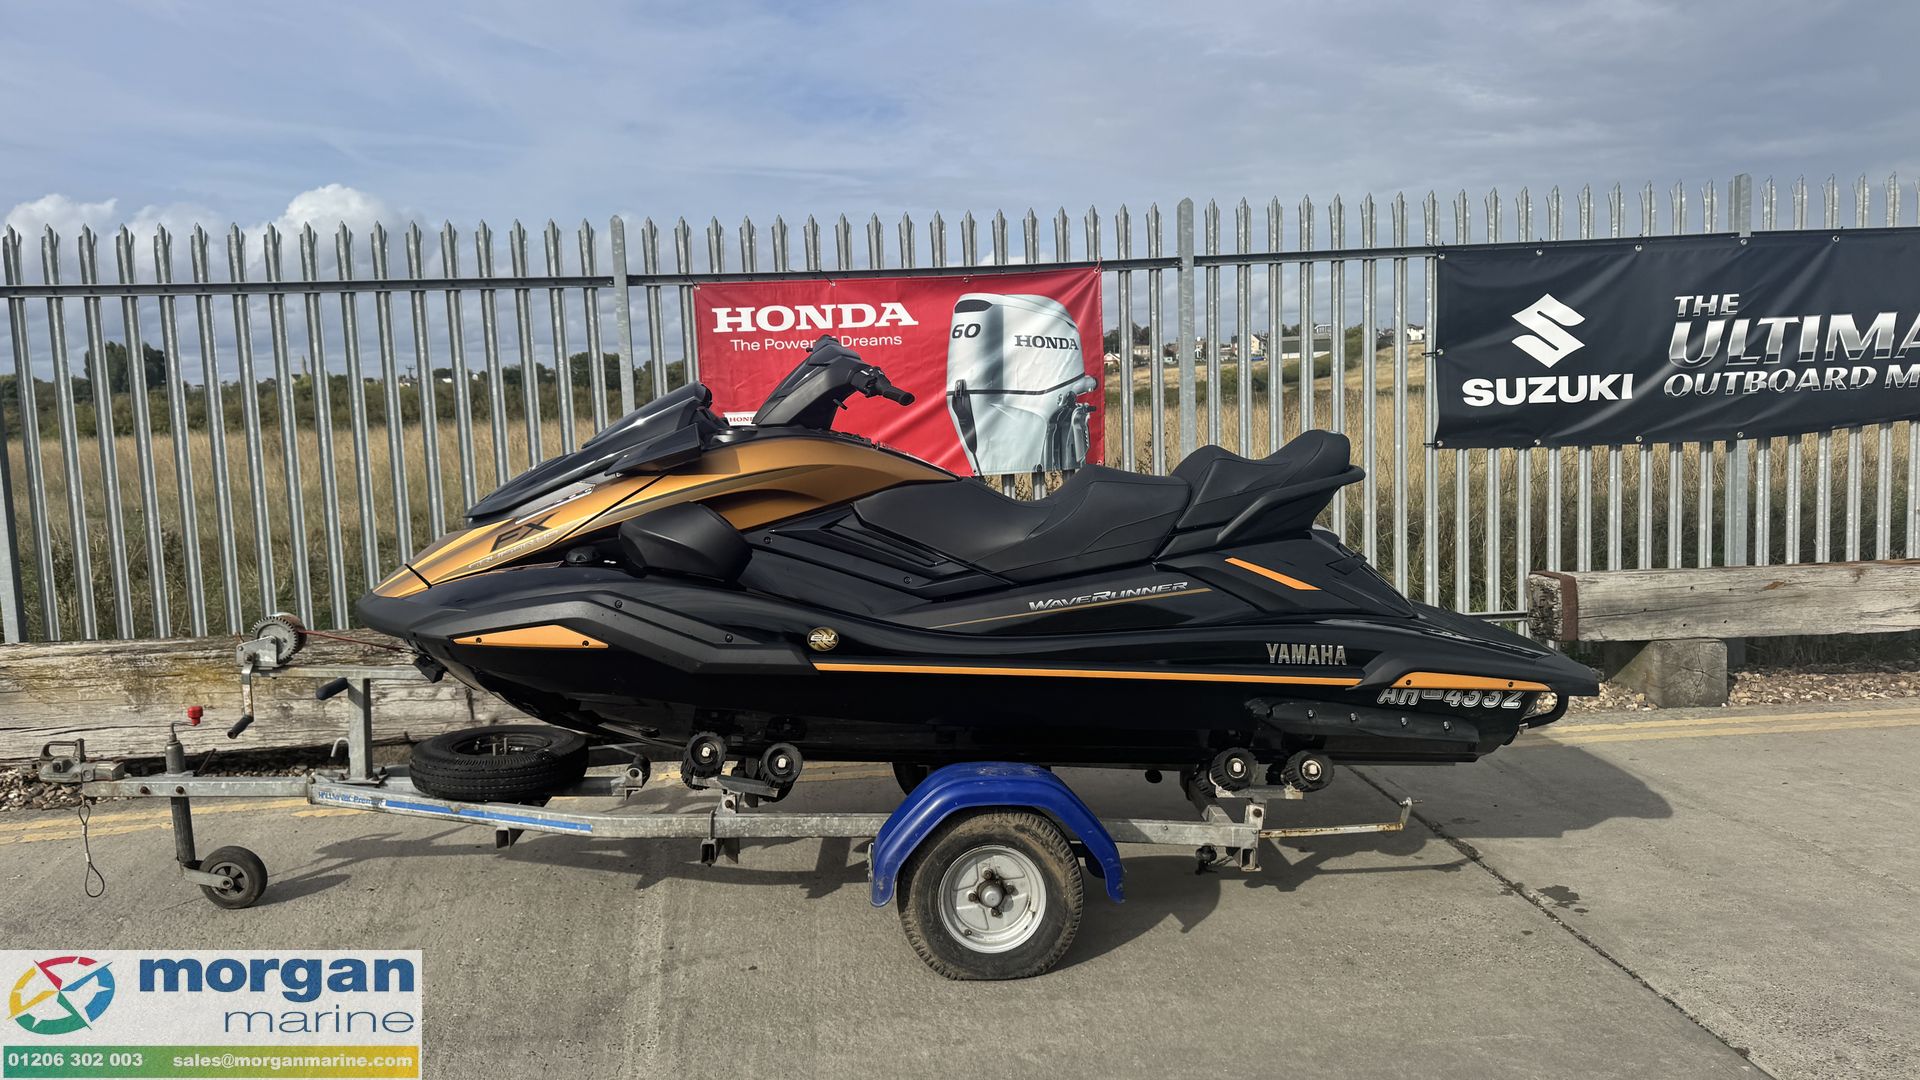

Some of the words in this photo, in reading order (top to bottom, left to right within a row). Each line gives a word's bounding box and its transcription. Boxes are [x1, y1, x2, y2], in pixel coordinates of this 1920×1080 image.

[1674, 293, 1740, 317] THE
[711, 302, 919, 333] HONDA
[951, 323, 981, 338] 60
[1013, 334, 1079, 351] HONDA
[730, 339, 761, 351] The
[764, 338, 815, 351] Power
[841, 335, 903, 347] Dreams
[1461, 373, 1634, 407] SUZUKI
[1663, 366, 1878, 397] OUTBOARD
[489, 511, 560, 553] FX
[1265, 642, 1347, 666] YAMAHA
